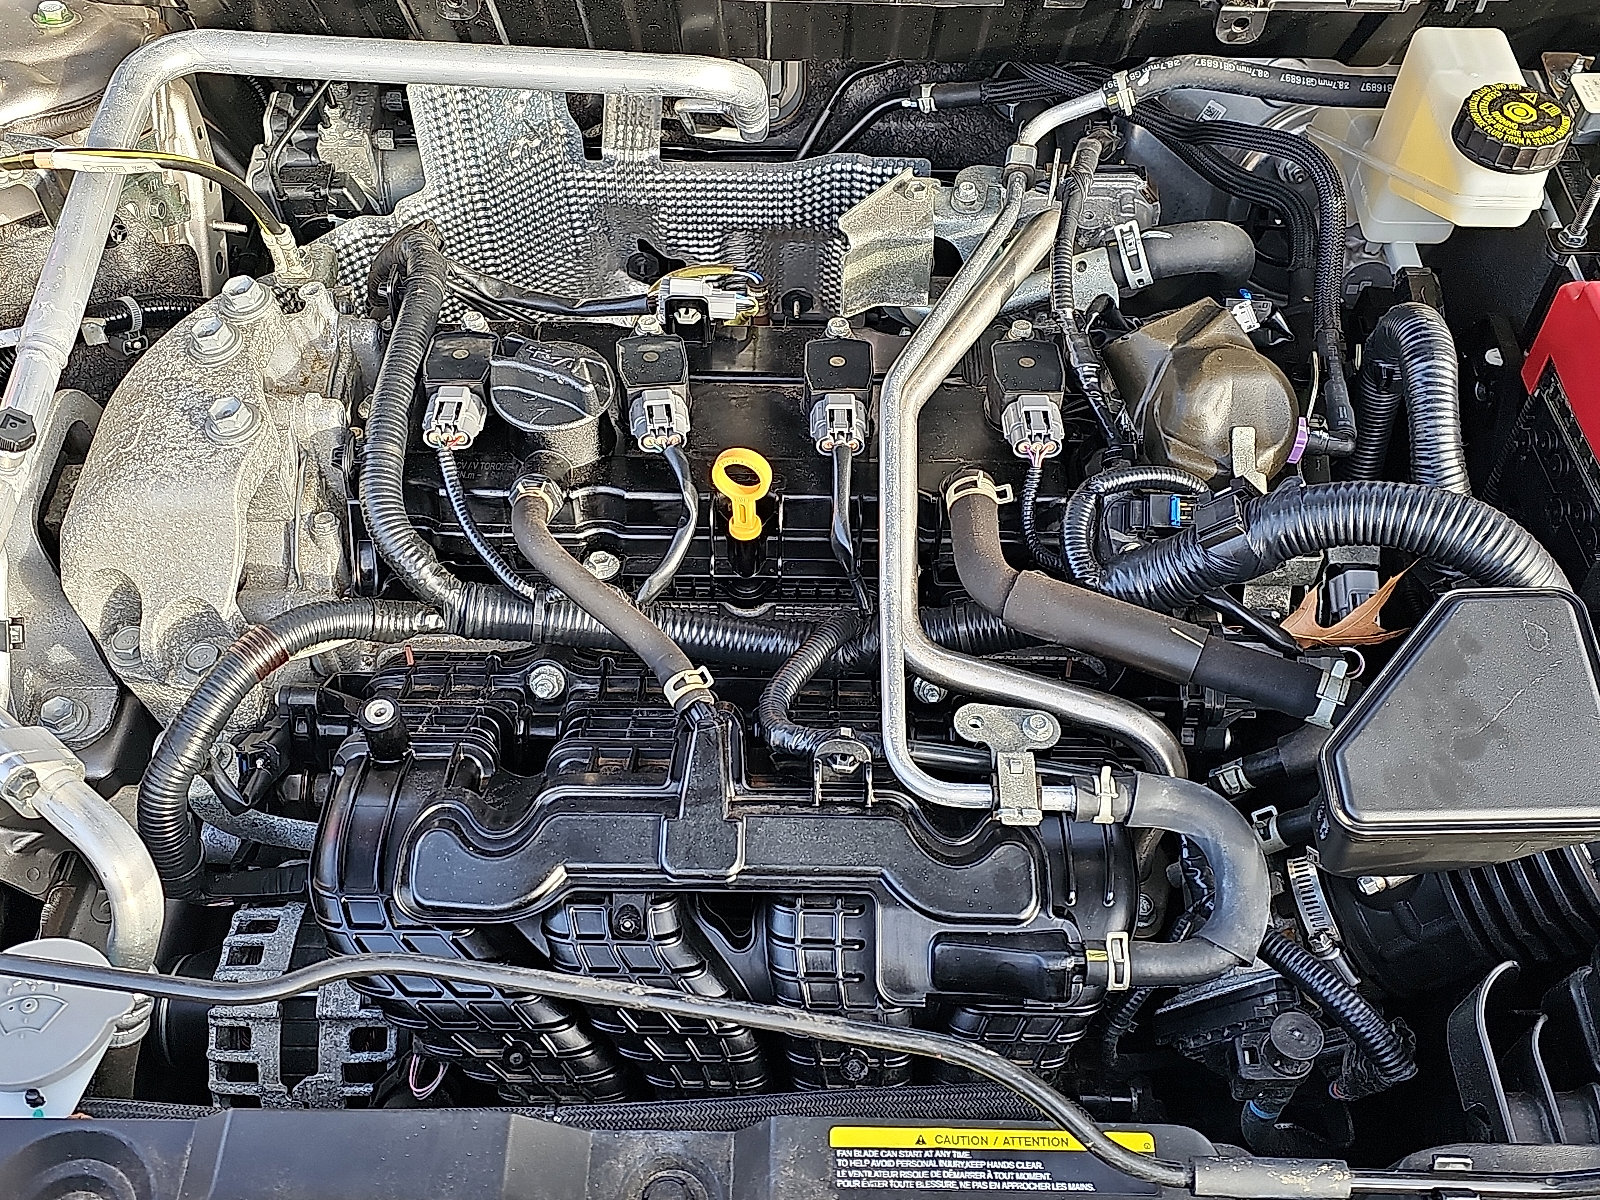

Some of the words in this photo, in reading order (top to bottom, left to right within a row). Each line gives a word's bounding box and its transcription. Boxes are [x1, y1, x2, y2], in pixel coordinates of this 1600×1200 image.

[1360, 82, 1393, 93] B16897
[1493, 122, 1521, 137] BEFORE
[1504, 134, 1524, 144] FROM
[934, 1134, 988, 1146] CAUTION
[1002, 1136, 1069, 1147] ATTENTION
[836, 1149, 853, 1158] FAN
[853, 1149, 880, 1158] BLADE
[880, 1149, 898, 1158] CAN
[898, 1150, 924, 1158] START
[923, 1150, 934, 1158] AT
[934, 1150, 951, 1158] ANY
[836, 1158, 849, 1167] TO
[849, 1159, 871, 1168] HELP
[871, 1159, 895, 1168] AVOID
[896, 1159, 939, 1168] PERSONAL
[986, 1161, 1015, 1170] HANDS
[1015, 1161, 1045, 1170] CLEAR.
[836, 1170, 847, 1178] LE
[847, 1170, 899, 1178] VENTILATEUR
[930, 1171, 942, 1179] DE
[942, 1169, 986, 1180] DÉMARRER
[986, 1170, 994, 1180] À
[993, 1171, 1015, 1180] TOUT
[836, 1179, 861, 1188] POUR
[889, 1180, 915, 1189] TOUTE
[960, 1181, 972, 1190] NE
[972, 1181, 989, 1190] PAS
[989, 1181, 1001, 1190] EN
[1001, 1181, 1052, 1191] APPROCHER
[1052, 1182, 1068, 1191] LES
[1068, 1182, 1096, 1192] MAINS.
